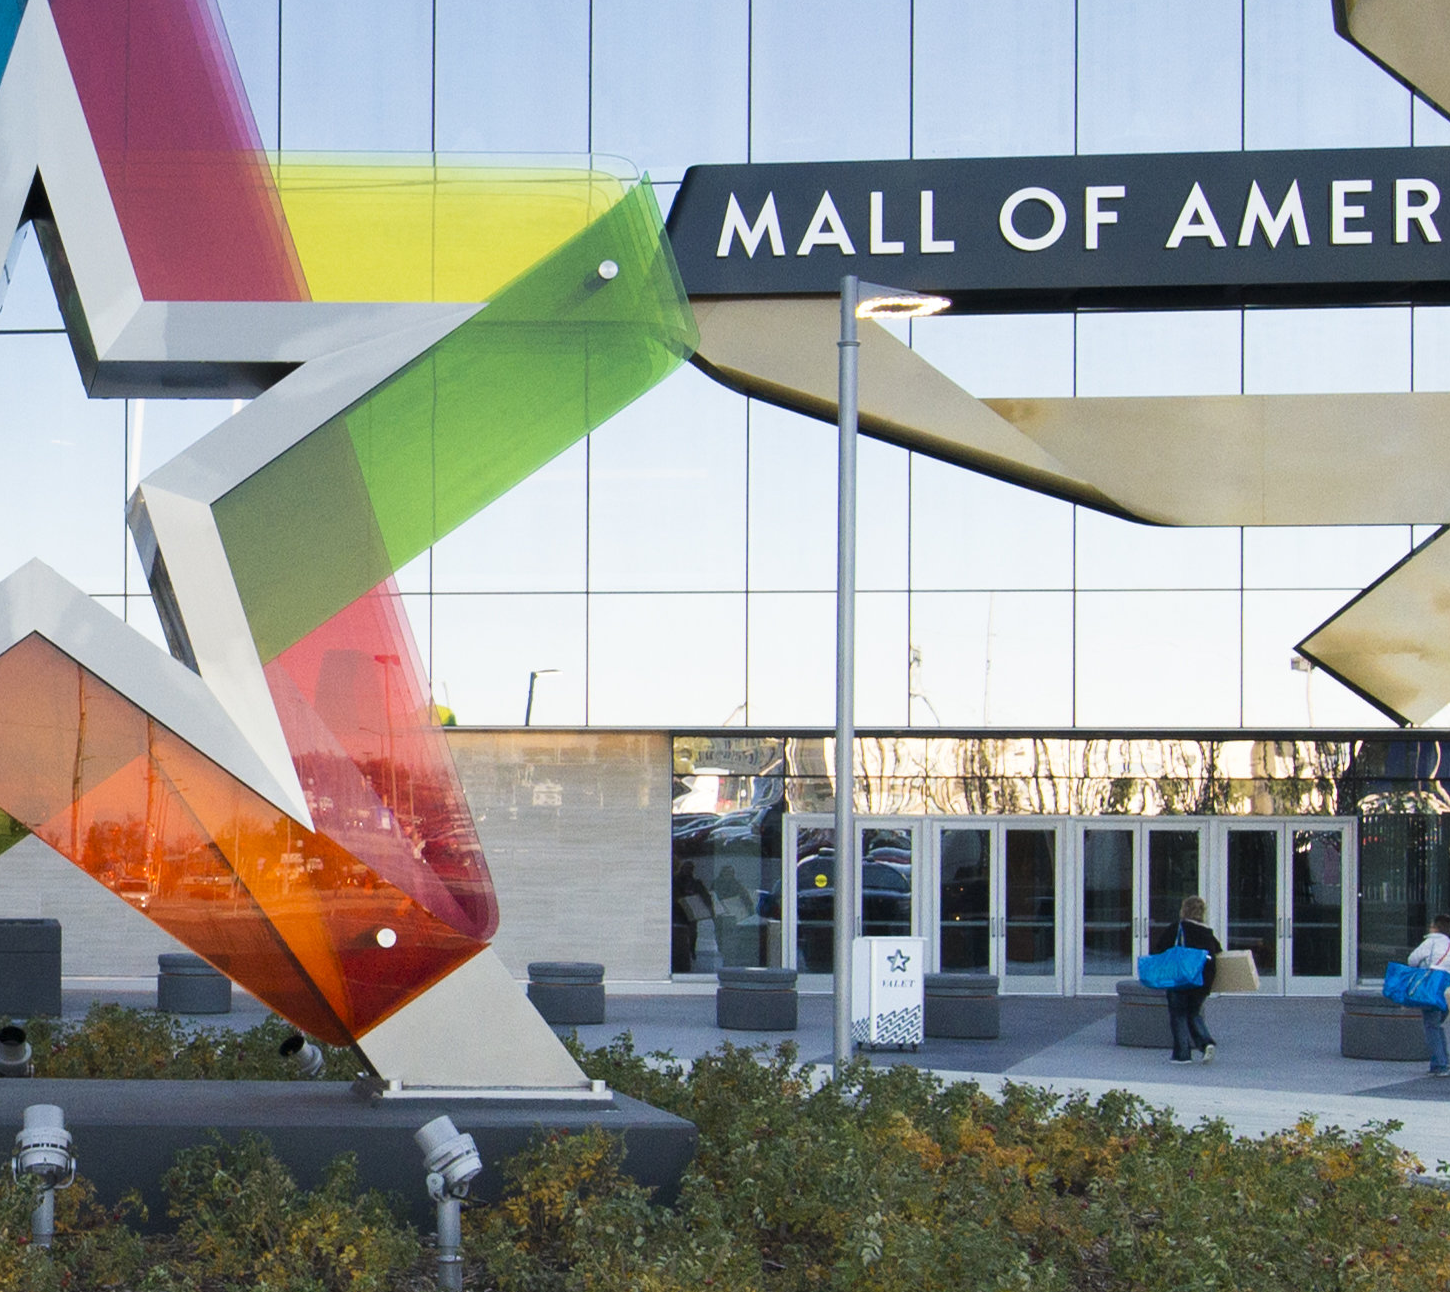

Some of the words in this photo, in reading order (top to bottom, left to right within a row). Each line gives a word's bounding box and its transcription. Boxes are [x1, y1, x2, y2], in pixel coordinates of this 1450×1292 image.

[716, 190, 955, 259] MALL
[999, 185, 1126, 252] OF
[881, 979, 916, 988] VALET
